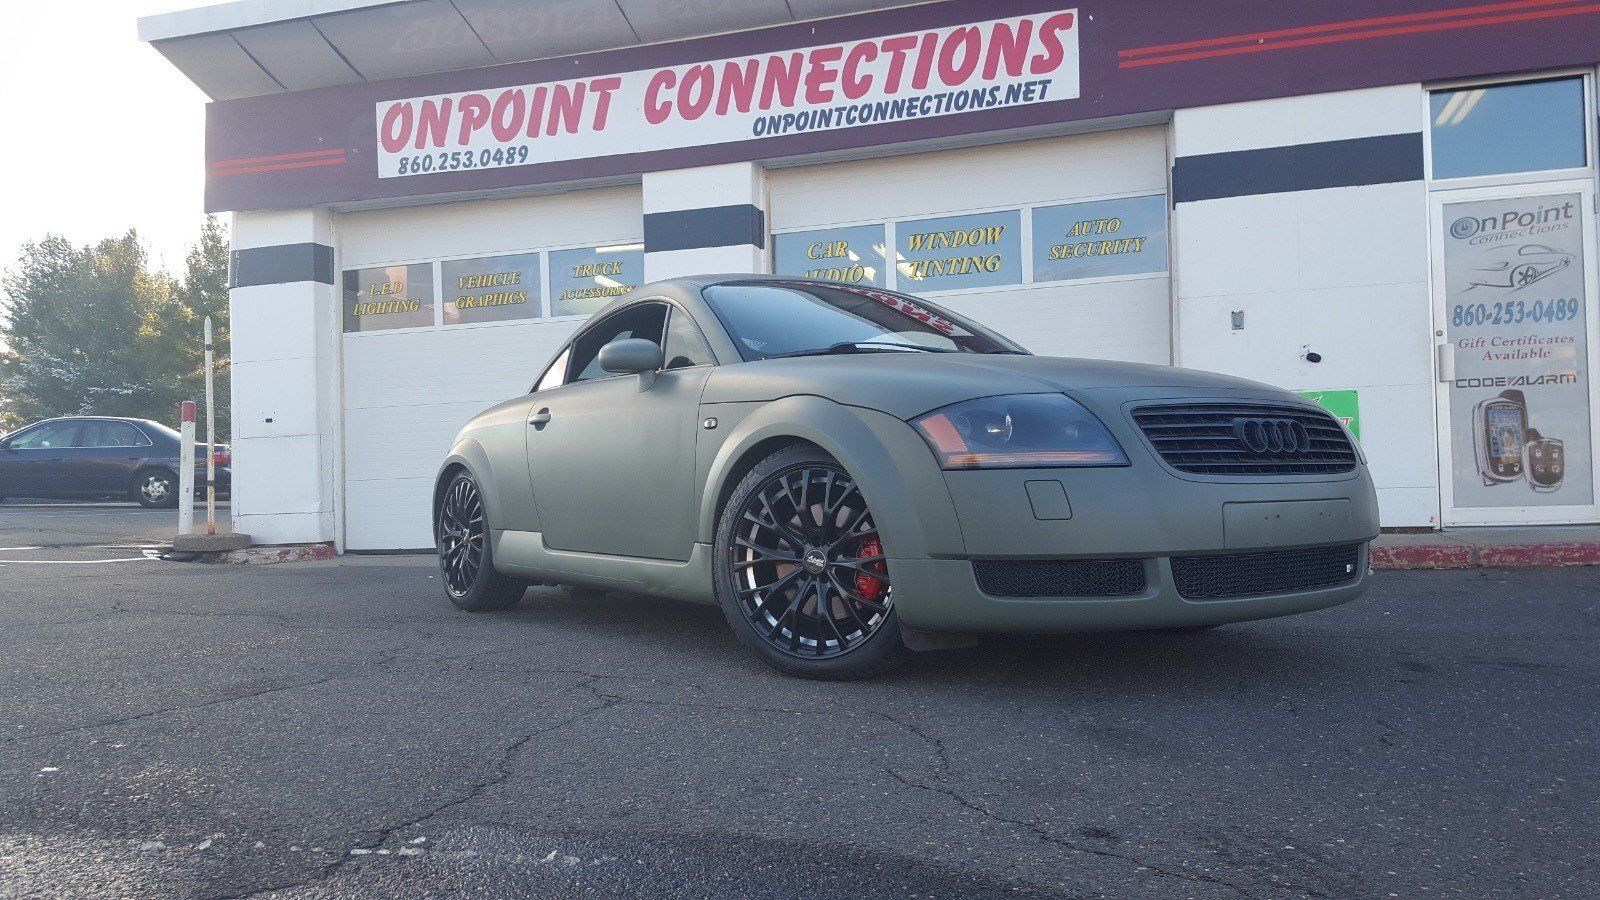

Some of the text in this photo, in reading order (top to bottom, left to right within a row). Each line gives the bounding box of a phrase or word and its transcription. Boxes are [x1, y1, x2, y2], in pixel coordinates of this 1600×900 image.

[381, 77, 621, 153] ONPOINT
[643, 12, 1075, 125] CONNECTIONS
[752, 79, 1053, 137] ONPOINTCONNECTIONS.NET
[398, 145, 529, 175] 860.253.0489
[1066, 217, 1122, 238] AUTO
[908, 225, 1007, 252] WINDOW
[1047, 236, 1147, 261] SECURITY
[806, 241, 849, 260] CAR
[573, 261, 623, 279] TRUCK
[909, 253, 1003, 279] TINTING
[458, 271, 521, 290] VEHICLE
[352, 299, 420, 317] LIGHTING
[454, 290, 528, 309] GRAPHICS
[1452, 298, 1579, 327] 860-253-0489
[1458, 334, 1575, 349] Gift Certificates
[1482, 347, 1551, 361] Available
